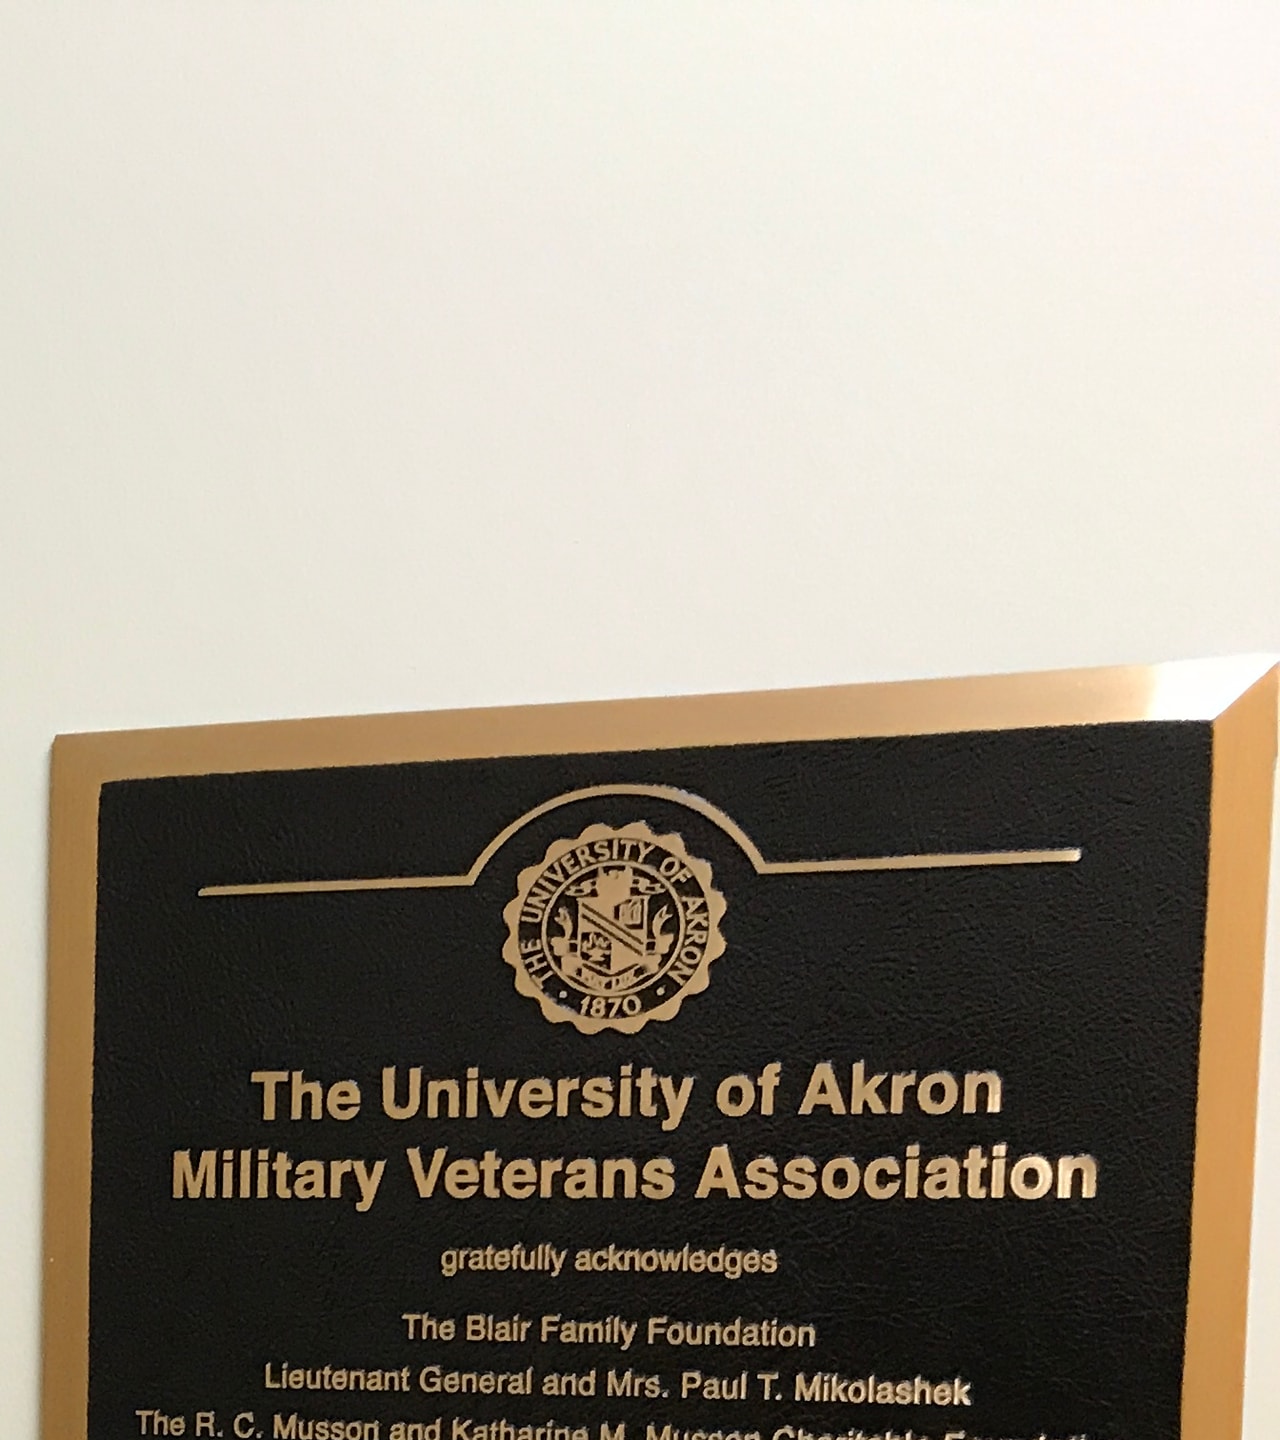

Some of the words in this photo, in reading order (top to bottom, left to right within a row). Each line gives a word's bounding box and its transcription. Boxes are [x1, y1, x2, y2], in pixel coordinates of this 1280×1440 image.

[521, 839, 655, 923] UNIVERSITY
[660, 857, 692, 884] OF
[520, 938, 553, 988] THE
[667, 896, 709, 987] AKRON
[580, 995, 641, 1018] 1870
[251, 1071, 360, 1120] The
[382, 1063, 692, 1131] University
[716, 1062, 781, 1117] of
[798, 1060, 1003, 1115] Akron
[171, 1148, 386, 1212] Military
[406, 1147, 675, 1200] Veterans
[695, 1142, 1098, 1200] Association
[441, 1244, 566, 1276] gratefully
[575, 1243, 778, 1279] acknowledges
[401, 1313, 455, 1342] The
[466, 1314, 532, 1343] Blair
[540, 1314, 638, 1350] Family
[647, 1316, 815, 1348] Foundation
[264, 1363, 410, 1393] Lieutenant
[420, 1366, 533, 1396] General
[542, 1369, 596, 1396] and
[606, 1370, 669, 1399] Mrs.
[681, 1371, 747, 1401] Paul
[757, 1372, 782, 1401] T.
[795, 1372, 972, 1407] Mikolashek
[136, 1410, 185, 1438] The
[195, 1411, 223, 1439] R.
[233, 1411, 262, 1440] C.
